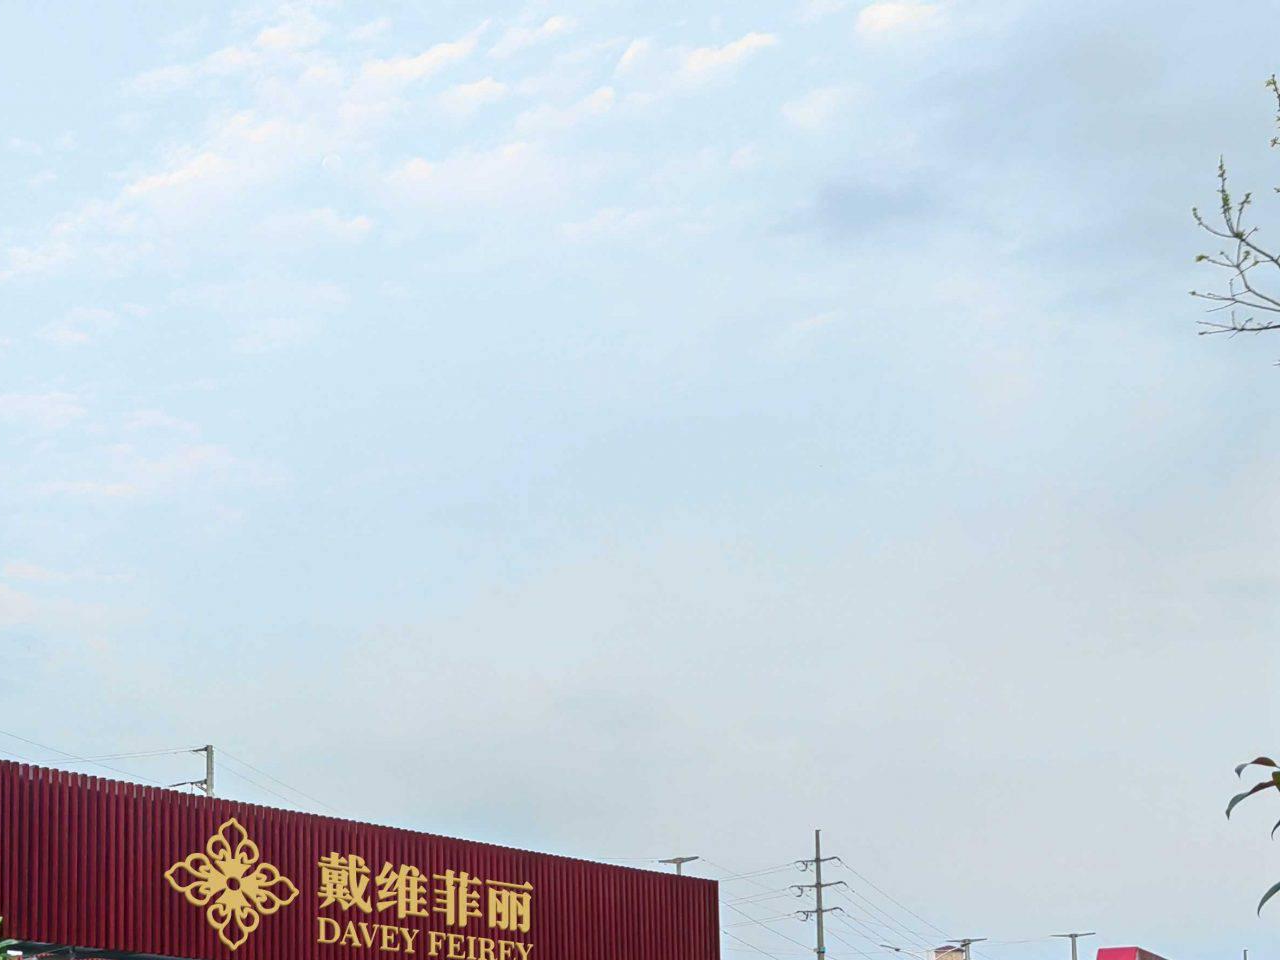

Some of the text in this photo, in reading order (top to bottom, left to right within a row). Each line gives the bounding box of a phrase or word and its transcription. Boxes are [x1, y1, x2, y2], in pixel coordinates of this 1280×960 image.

[317, 851, 534, 933] 戴维菲丽
[317, 917, 420, 954] DAVEY
